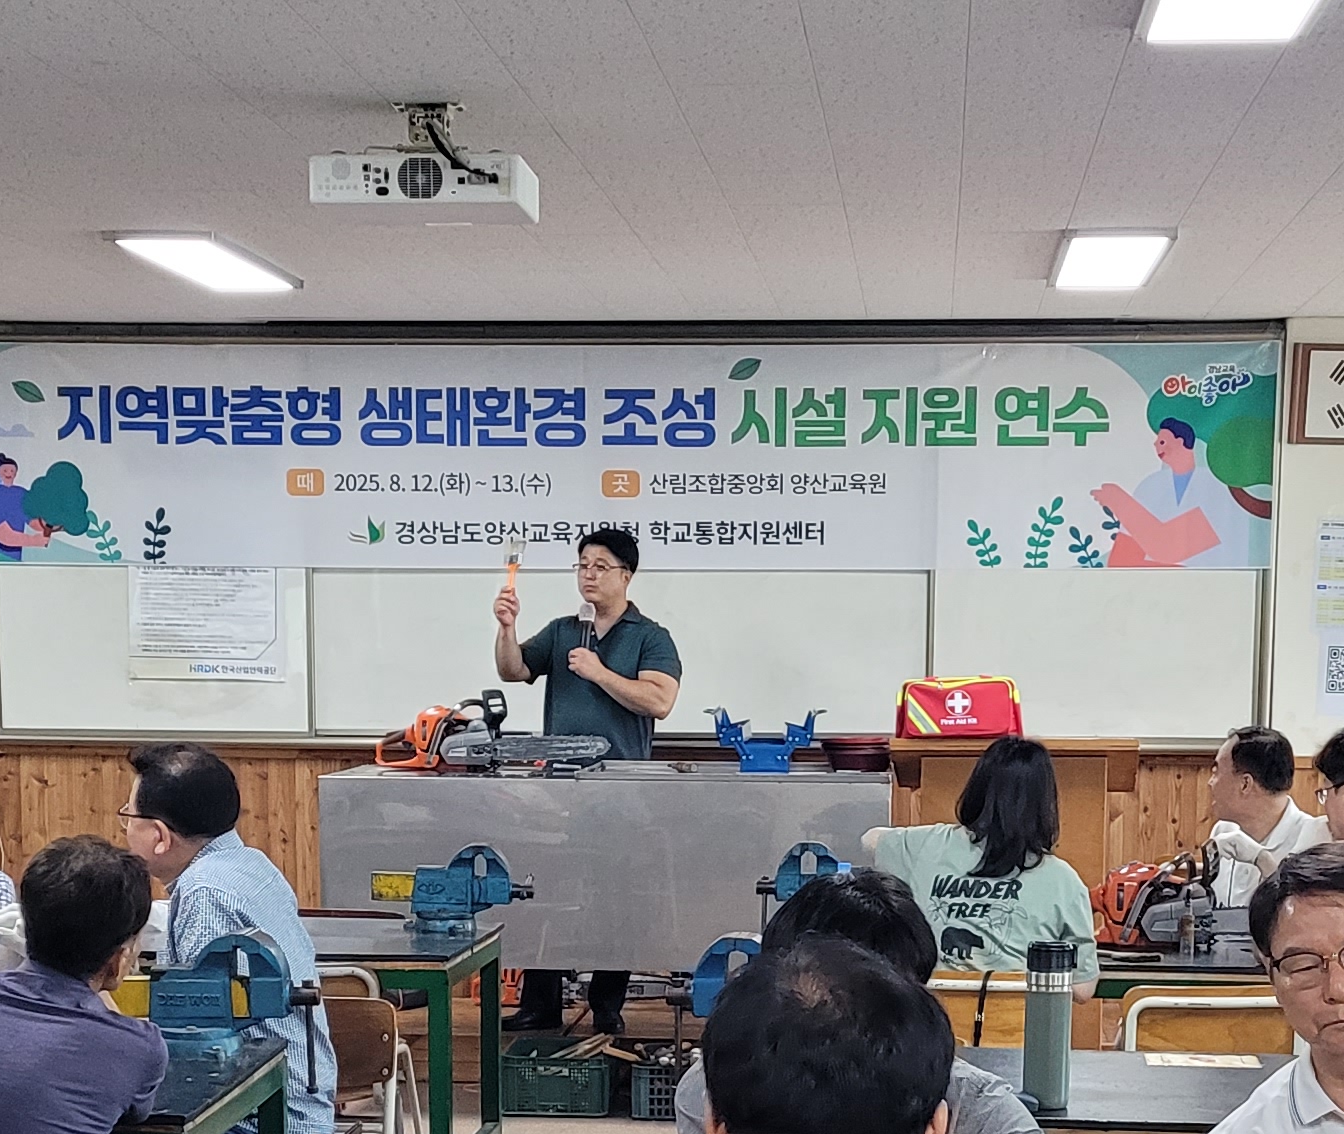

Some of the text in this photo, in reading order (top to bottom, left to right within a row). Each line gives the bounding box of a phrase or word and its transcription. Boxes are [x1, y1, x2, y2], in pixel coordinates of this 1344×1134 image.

[58, 385, 1111, 448] 지역맞춤형 생태환경 조성 시설 지원 연수
[296, 472, 315, 493] 때
[333, 473, 385, 492] 2025.
[388, 473, 406, 492] 8.
[410, 472, 471, 497] 12.(화)
[491, 472, 552, 497] 13.(수)
[611, 472, 887, 495] 곳 산림조합중앙회 양산교육원
[647, 519, 826, 547] 학교통합지원센터
[189, 664, 220, 674] HRDK
[940, 718, 955, 726] First
[968, 717, 978, 725] Kit
[930, 873, 1024, 901] WANDER
[946, 902, 992, 919] FREE
